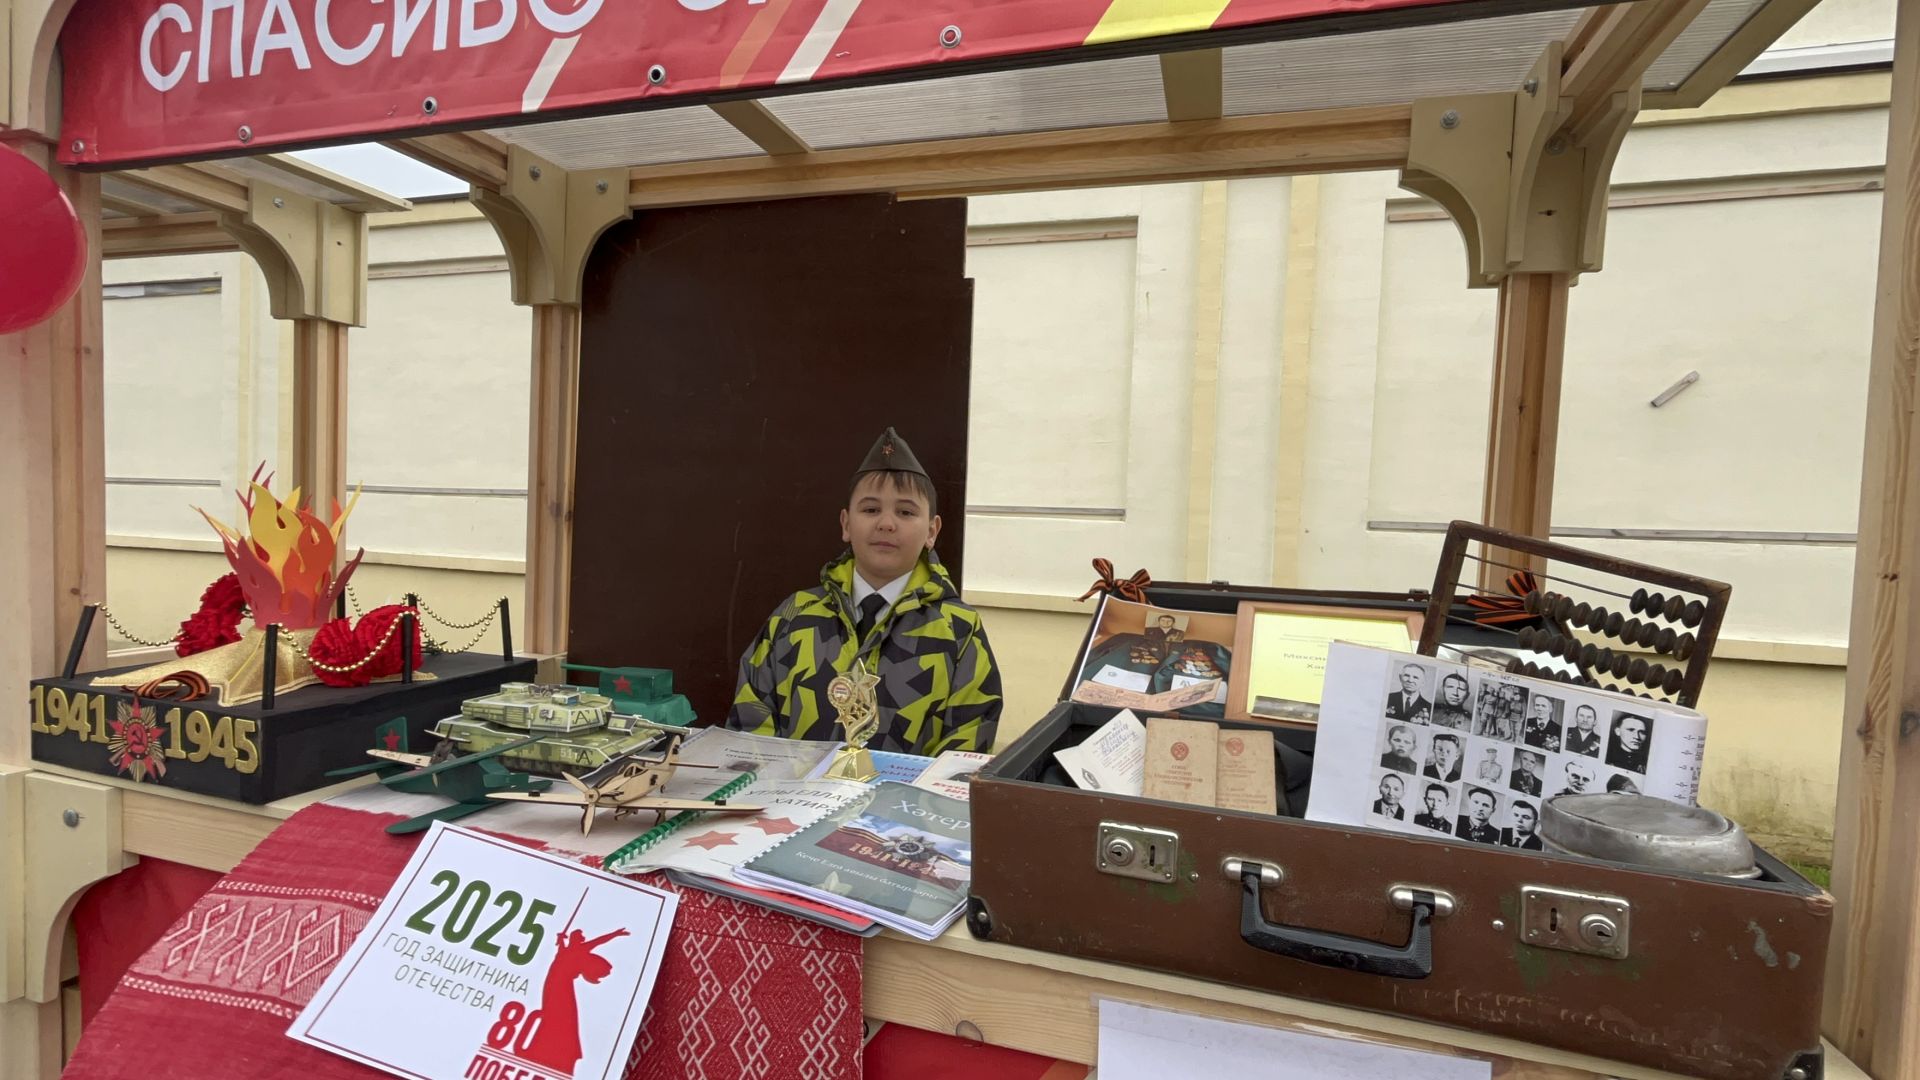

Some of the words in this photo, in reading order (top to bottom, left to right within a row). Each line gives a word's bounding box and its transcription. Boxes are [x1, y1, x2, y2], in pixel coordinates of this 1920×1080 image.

[29, 685, 111, 744] 1941
[164, 707, 258, 774] 1945
[405, 869, 557, 966] 2025
[382, 932, 421, 960] ГОД
[421, 945, 530, 996] ЗАЩИТНИКА
[394, 964, 495, 1012] ОТЕЧЕСТВА
[486, 1001, 544, 1057] 80
